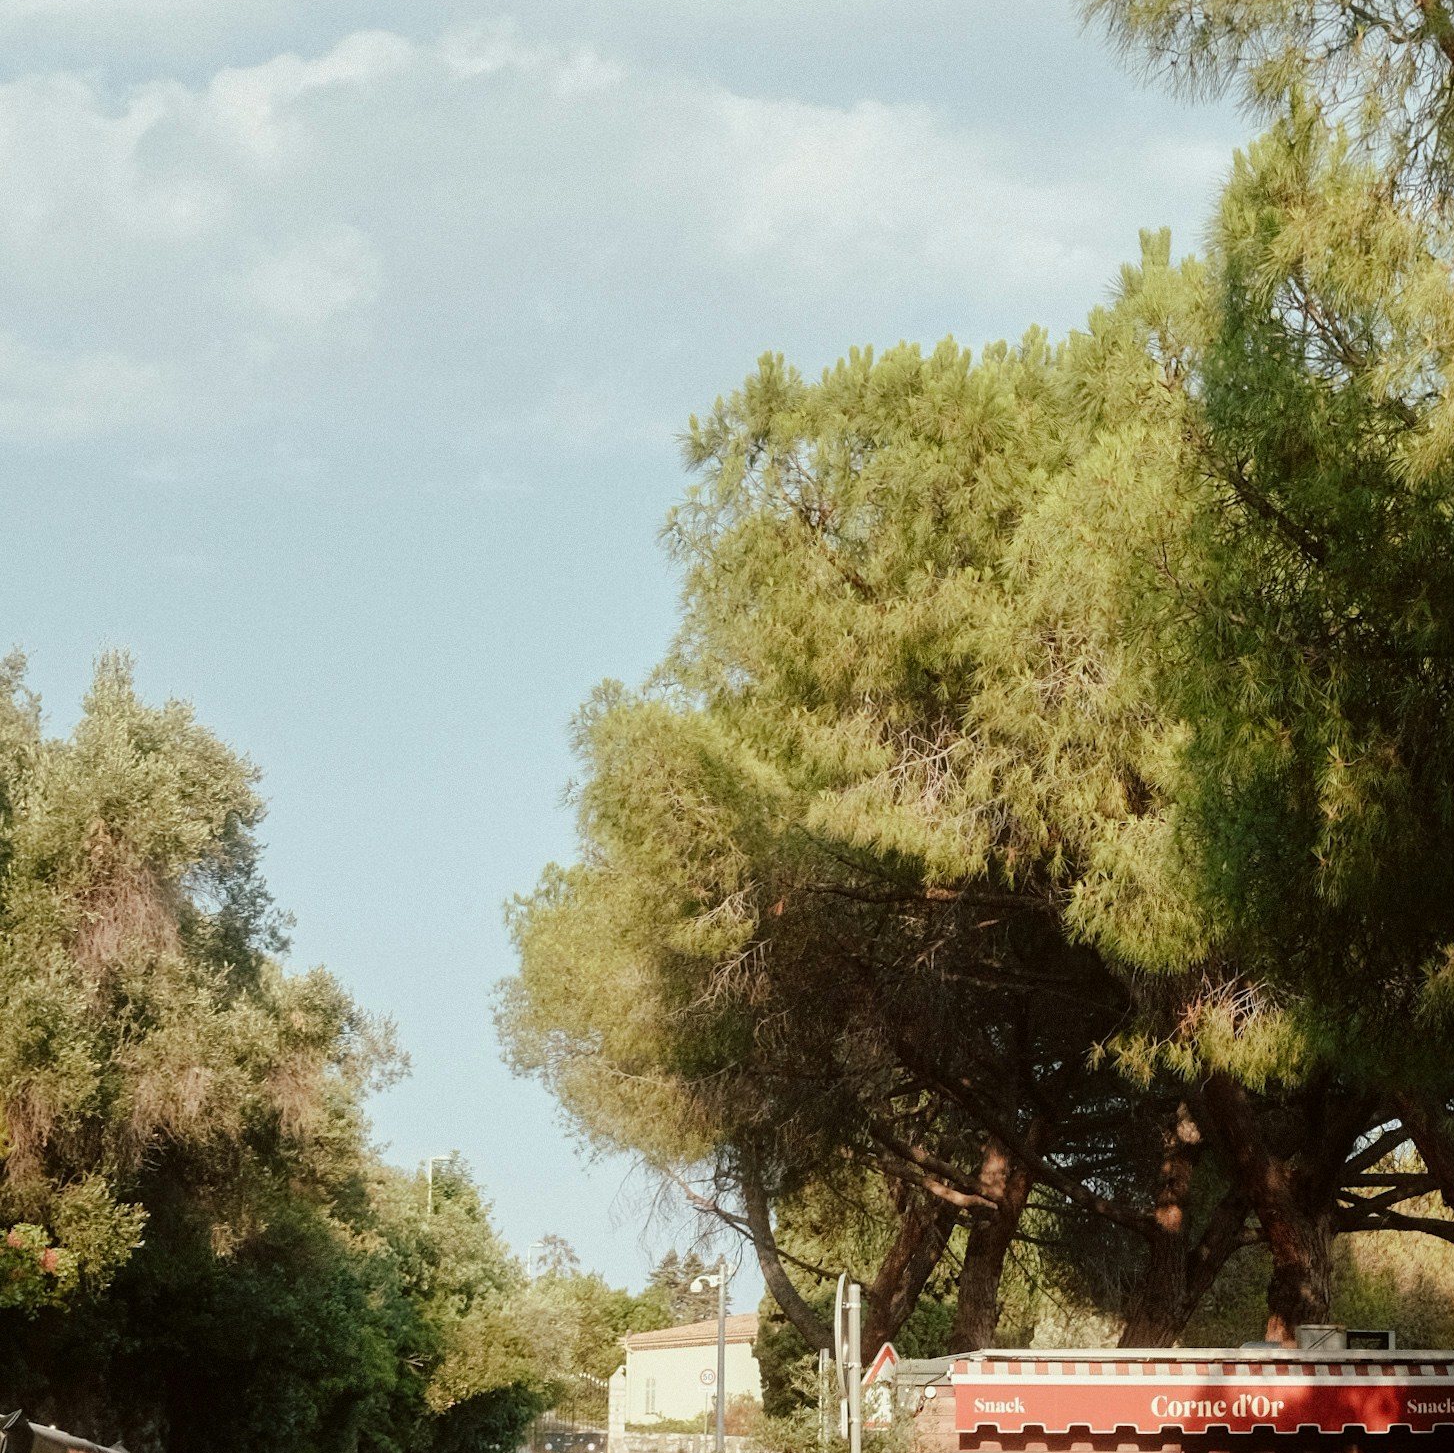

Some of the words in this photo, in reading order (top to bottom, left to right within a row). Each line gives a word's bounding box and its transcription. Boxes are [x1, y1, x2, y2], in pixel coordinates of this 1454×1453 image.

[974, 1397, 1025, 1414] Snack
[1151, 1395, 1227, 1418] Corne
[1232, 1394, 1285, 1418] d'Or
